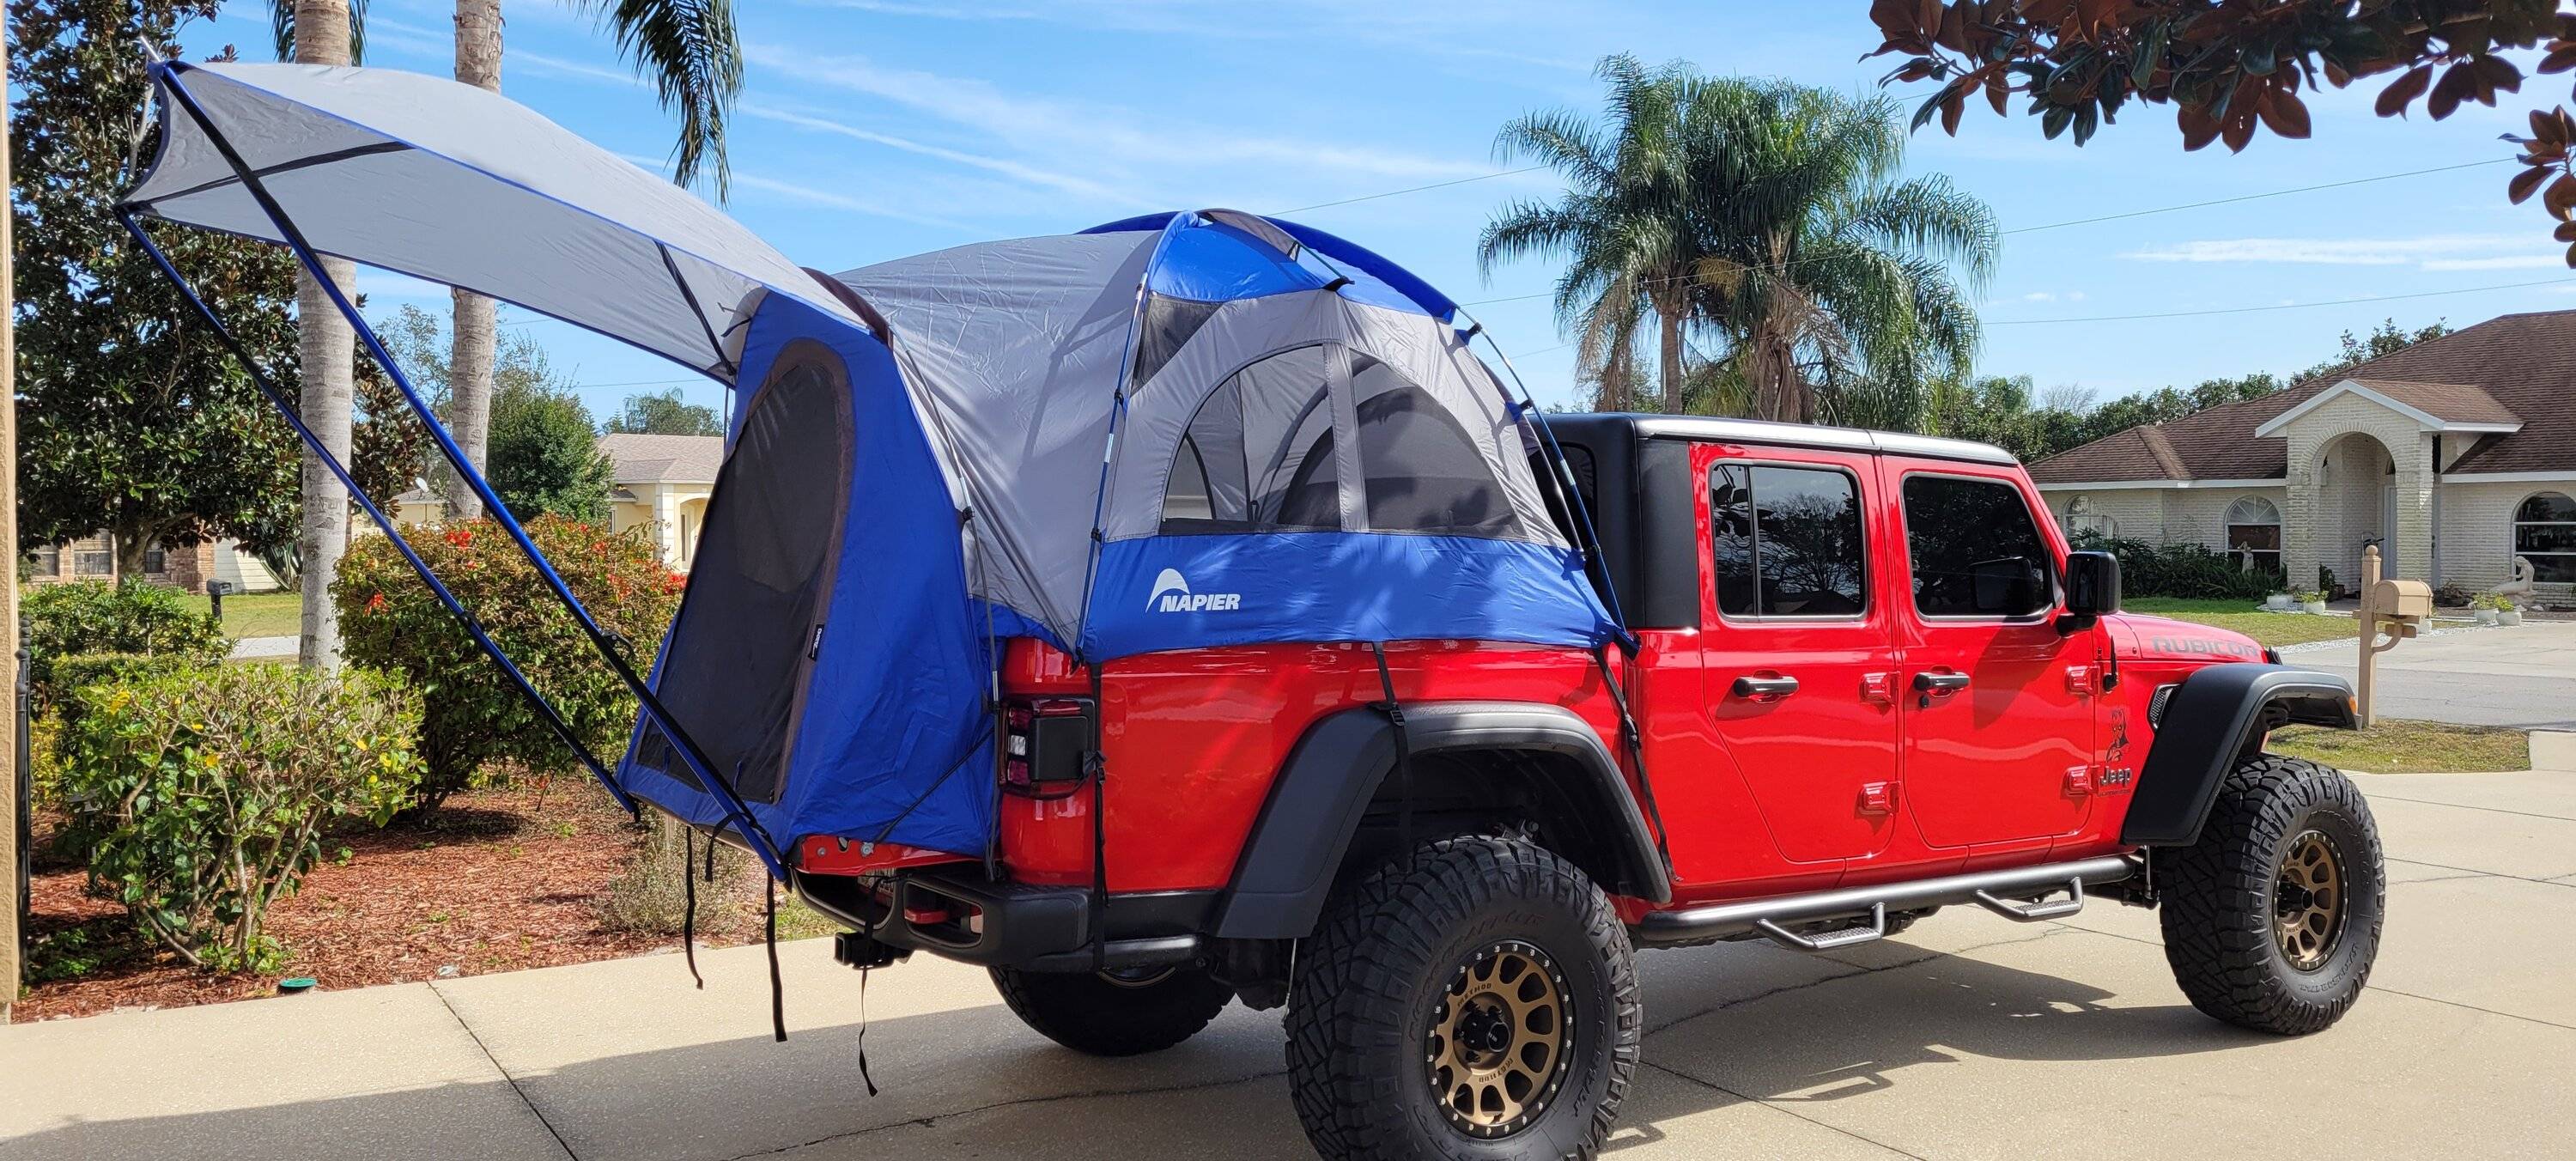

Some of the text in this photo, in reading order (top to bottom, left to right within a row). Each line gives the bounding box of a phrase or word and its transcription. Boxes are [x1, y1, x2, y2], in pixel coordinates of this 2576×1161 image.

[1159, 593, 1241, 612] NAPIER
[2152, 635, 2258, 657] RUBICON
[2099, 765, 2132, 787] Jeep
[1457, 982, 1492, 1007] METHOD
